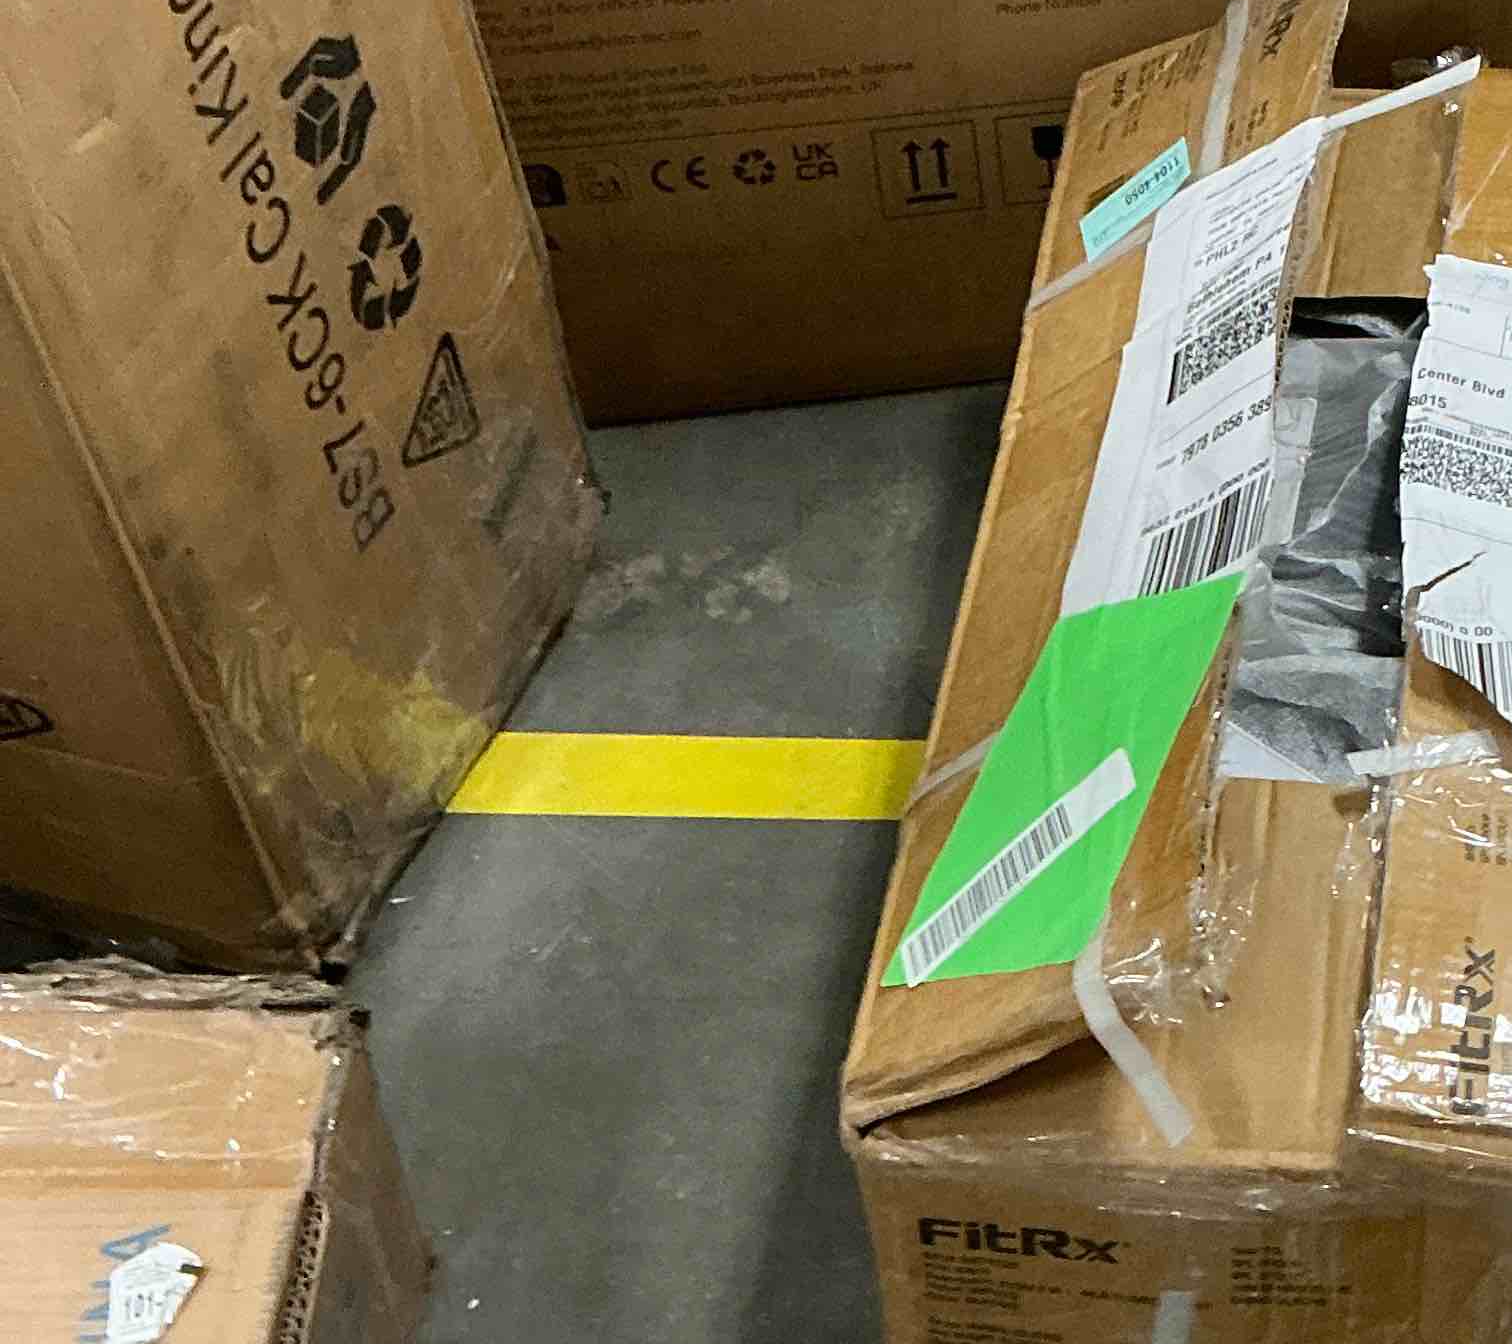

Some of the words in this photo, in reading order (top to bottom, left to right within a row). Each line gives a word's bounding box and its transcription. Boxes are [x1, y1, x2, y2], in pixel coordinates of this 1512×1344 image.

[218, 133, 291, 266] Cal
[1406, 391, 1448, 411] 8015
[1416, 366, 1467, 388] Center
[1471, 378, 1507, 400] Blvd
[917, 1216, 1121, 1264] FitRx
